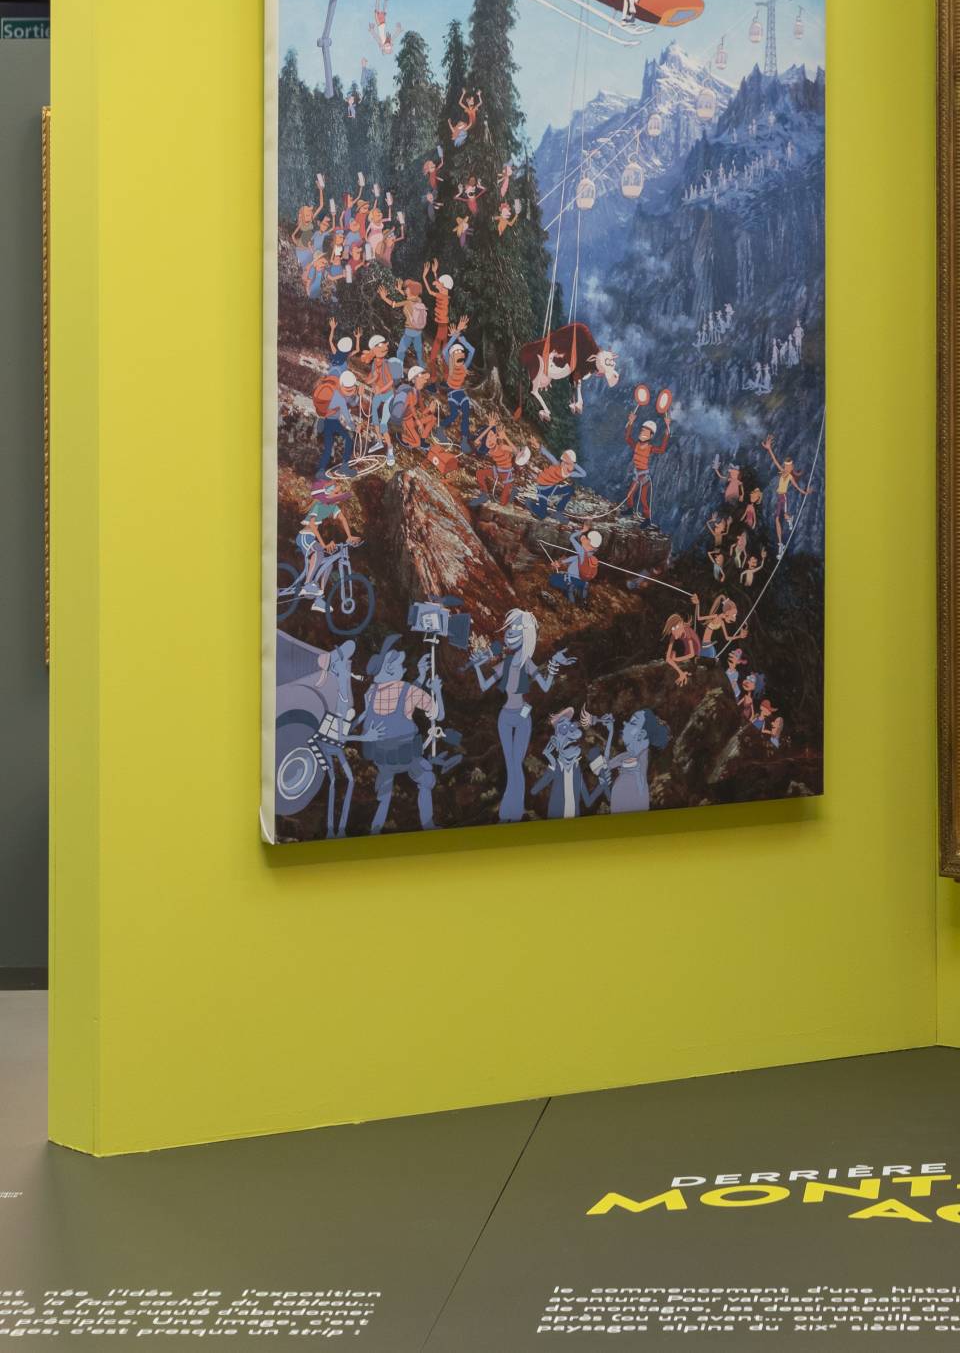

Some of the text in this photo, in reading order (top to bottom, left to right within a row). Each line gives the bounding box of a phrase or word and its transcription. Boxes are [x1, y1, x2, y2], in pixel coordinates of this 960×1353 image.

[670, 1162, 948, 1188] DERRIÈRE
[554, 1286, 573, 1294] le
[592, 1286, 789, 1294] commencement
[808, 1286, 873, 1294] d'une
[549, 1295, 657, 1303] aventure.
[667, 1295, 721, 1303] Pour
[728, 1295, 824, 1303] valoriser
[545, 1304, 573, 1312] de
[584, 1304, 711, 1314] montagne,
[723, 1304, 753, 1312] les
[764, 1304, 911, 1312] dessinateurs
[922, 1304, 949, 1312] de
[541, 1313, 602, 1323] après
[612, 1313, 648, 1323] (ou
[697, 1313, 783, 1322] avant...
[537, 1324, 647, 1333] paysages
[663, 1323, 734, 1333] alpins
[749, 1323, 779, 1331] du
[851, 1323, 920, 1331] siècle
